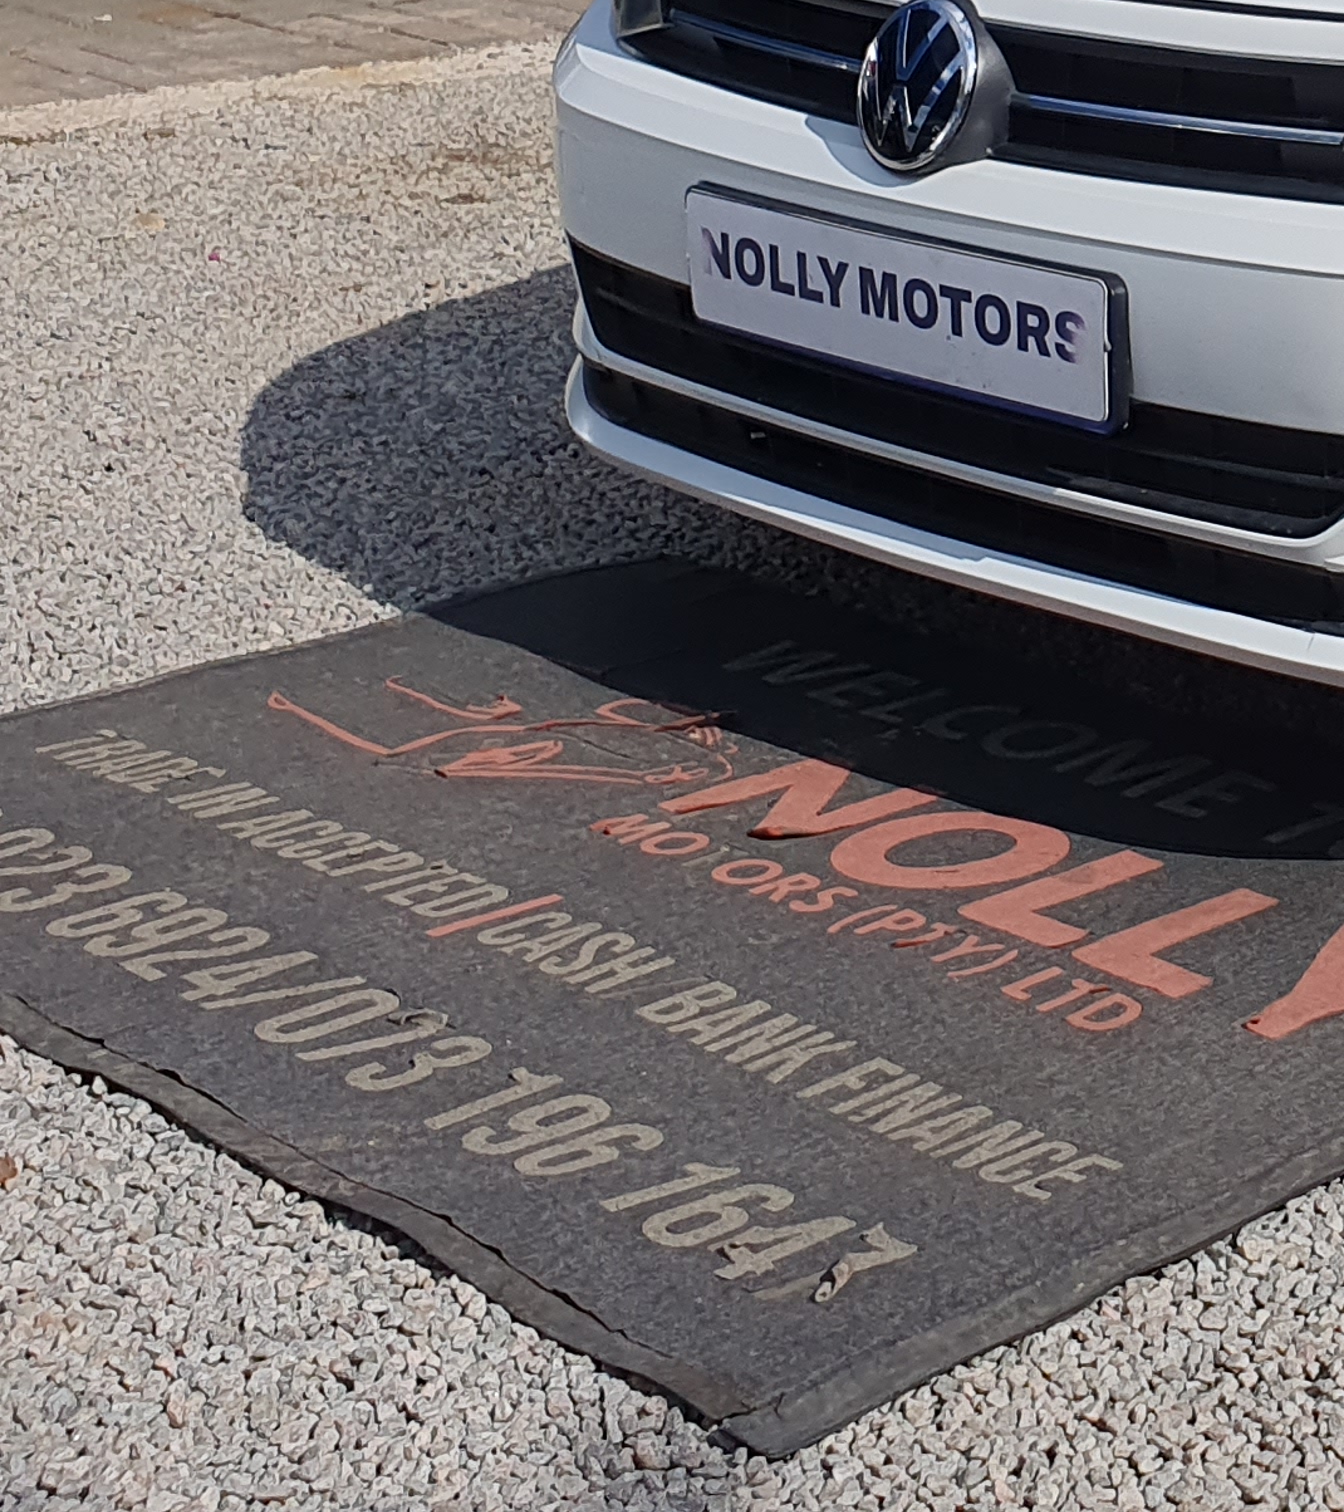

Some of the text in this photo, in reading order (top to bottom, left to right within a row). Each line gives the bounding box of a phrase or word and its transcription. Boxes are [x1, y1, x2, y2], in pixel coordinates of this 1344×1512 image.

[701, 226, 1088, 364] NOLLY MOTORS
[721, 638, 1275, 820] WELCOME
[34, 728, 227, 794] TRADE
[166, 782, 281, 819] IN
[796, 1055, 1124, 1202] FINANCE
[827, 904, 1018, 978] (PTY)
[1001, 966, 1143, 1032] LTD
[423, 1065, 666, 1178] 196
